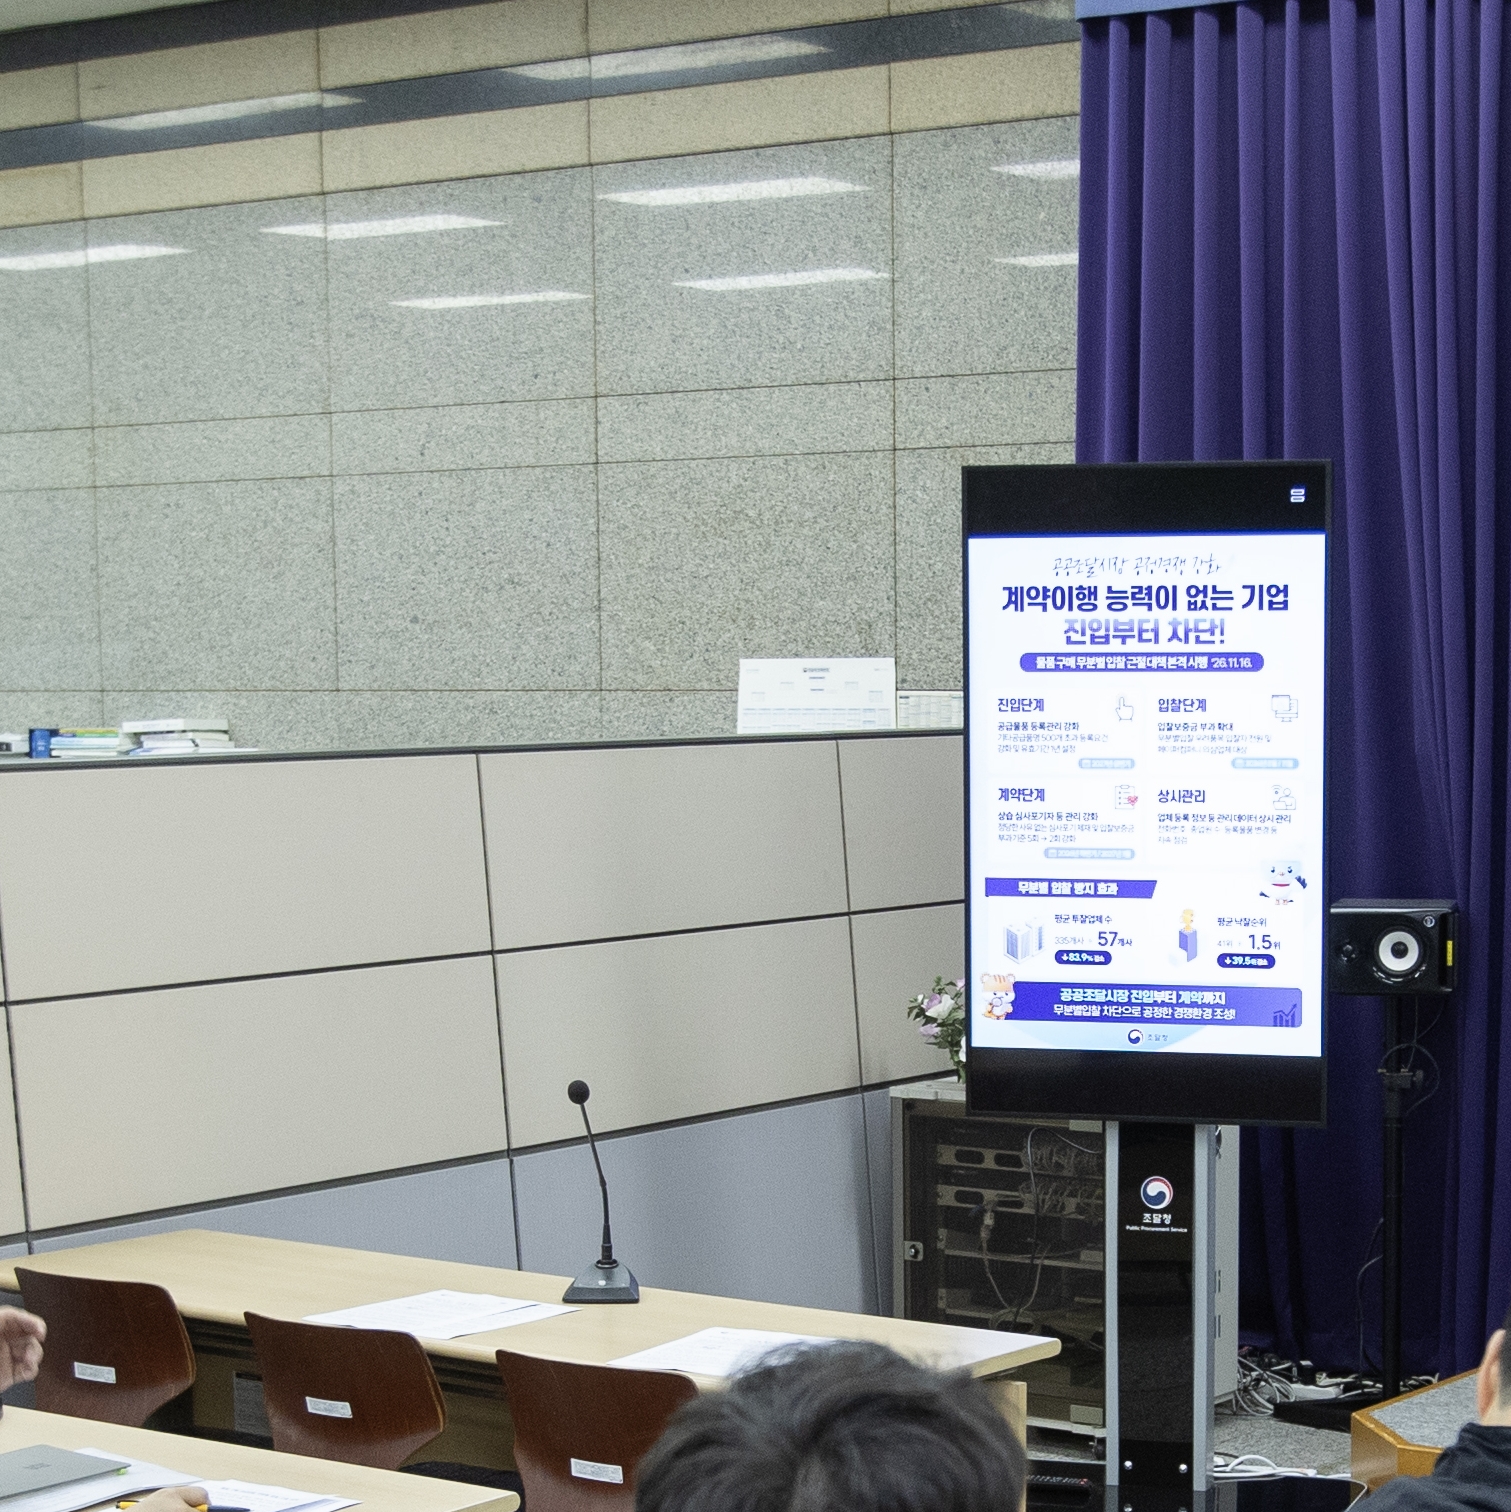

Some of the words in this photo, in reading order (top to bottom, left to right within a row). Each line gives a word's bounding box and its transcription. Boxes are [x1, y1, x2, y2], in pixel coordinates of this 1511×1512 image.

[1052, 556, 1129, 577] 공공조달시장
[1134, 556, 1186, 577] 공정경쟁
[1192, 553, 1221, 575] 강화
[1002, 584, 1098, 612] 계약이행
[1105, 584, 1177, 612] 능력이
[1186, 584, 1234, 612] 없는
[1241, 584, 1288, 612] 기업
[1063, 618, 1160, 645] 진입부터
[1167, 618, 1225, 645] 차단!
[997, 698, 1045, 712] 진입단계
[1158, 698, 1207, 712] 입찰단계
[1063, 721, 1080, 731] 강화
[1200, 722, 1216, 732] 부과
[998, 788, 1045, 802] 계약단계
[1158, 789, 1206, 803] 상시관리
[997, 811, 1013, 821] 상습
[1015, 811, 1055, 821] 심사포기자
[1056, 811, 1063, 821] 등
[1065, 811, 1081, 821] 관리
[1082, 811, 1099, 821] 강화
[1191, 813, 1207, 823] 정보
[1208, 813, 1215, 823] 등
[1216, 813, 1233, 823] 관리
[1233, 813, 1258, 823] 데이터
[1258, 813, 1274, 823] 상시
[1275, 813, 1292, 823] 관리
[1018, 881, 1049, 895] 무분별
[1051, 881, 1072, 895] 입찰
[1073, 881, 1095, 895] 방지
[1096, 881, 1119, 895] 효과
[1054, 914, 1070, 924] 평균
[1104, 914, 1113, 924] 수
[1217, 917, 1233, 927] 평균
[1059, 988, 1129, 1003] 공공조달시장
[1130, 990, 1177, 1004] 진입부터
[1178, 991, 1226, 1005] 계약까지
[1053, 1004, 1101, 1016] 무분별입찰
[1102, 1005, 1142, 1017] 차단으로
[1143, 1006, 1173, 1019] 공정한
[1174, 1007, 1213, 1020] 경쟁환경
[1214, 1008, 1236, 1021] 조성!
[1147, 1033, 1169, 1042] 조달청
[1142, 1213, 1172, 1225] 조달청
